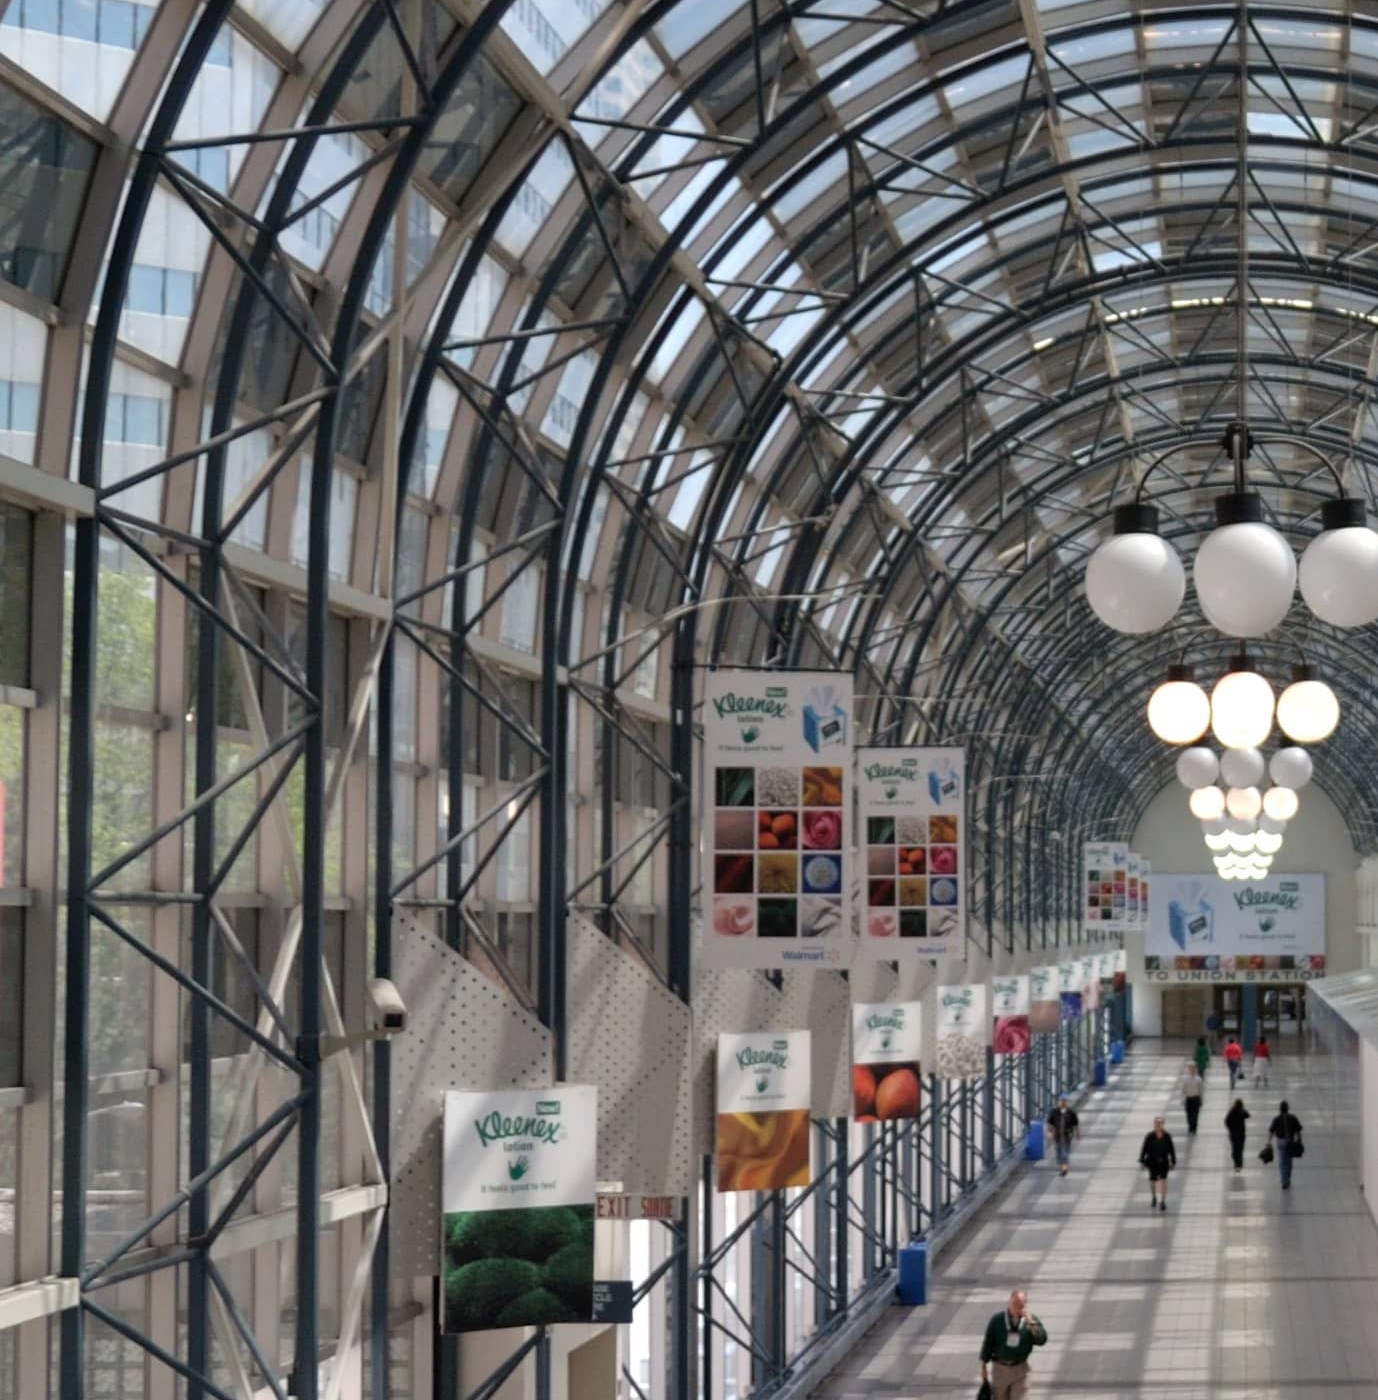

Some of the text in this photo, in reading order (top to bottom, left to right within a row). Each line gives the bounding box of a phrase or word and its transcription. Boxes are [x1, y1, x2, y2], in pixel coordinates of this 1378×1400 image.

[712, 692, 788, 719] Kleenex
[863, 763, 918, 782] Kleenex
[1233, 887, 1299, 911] Kleenex
[782, 950, 824, 960] Walmart
[1144, 971, 1326, 981] TO UNION STATION
[735, 1047, 789, 1071] Kleenex
[474, 1110, 561, 1147] Kleenex
[597, 1195, 631, 1218] EXIT
